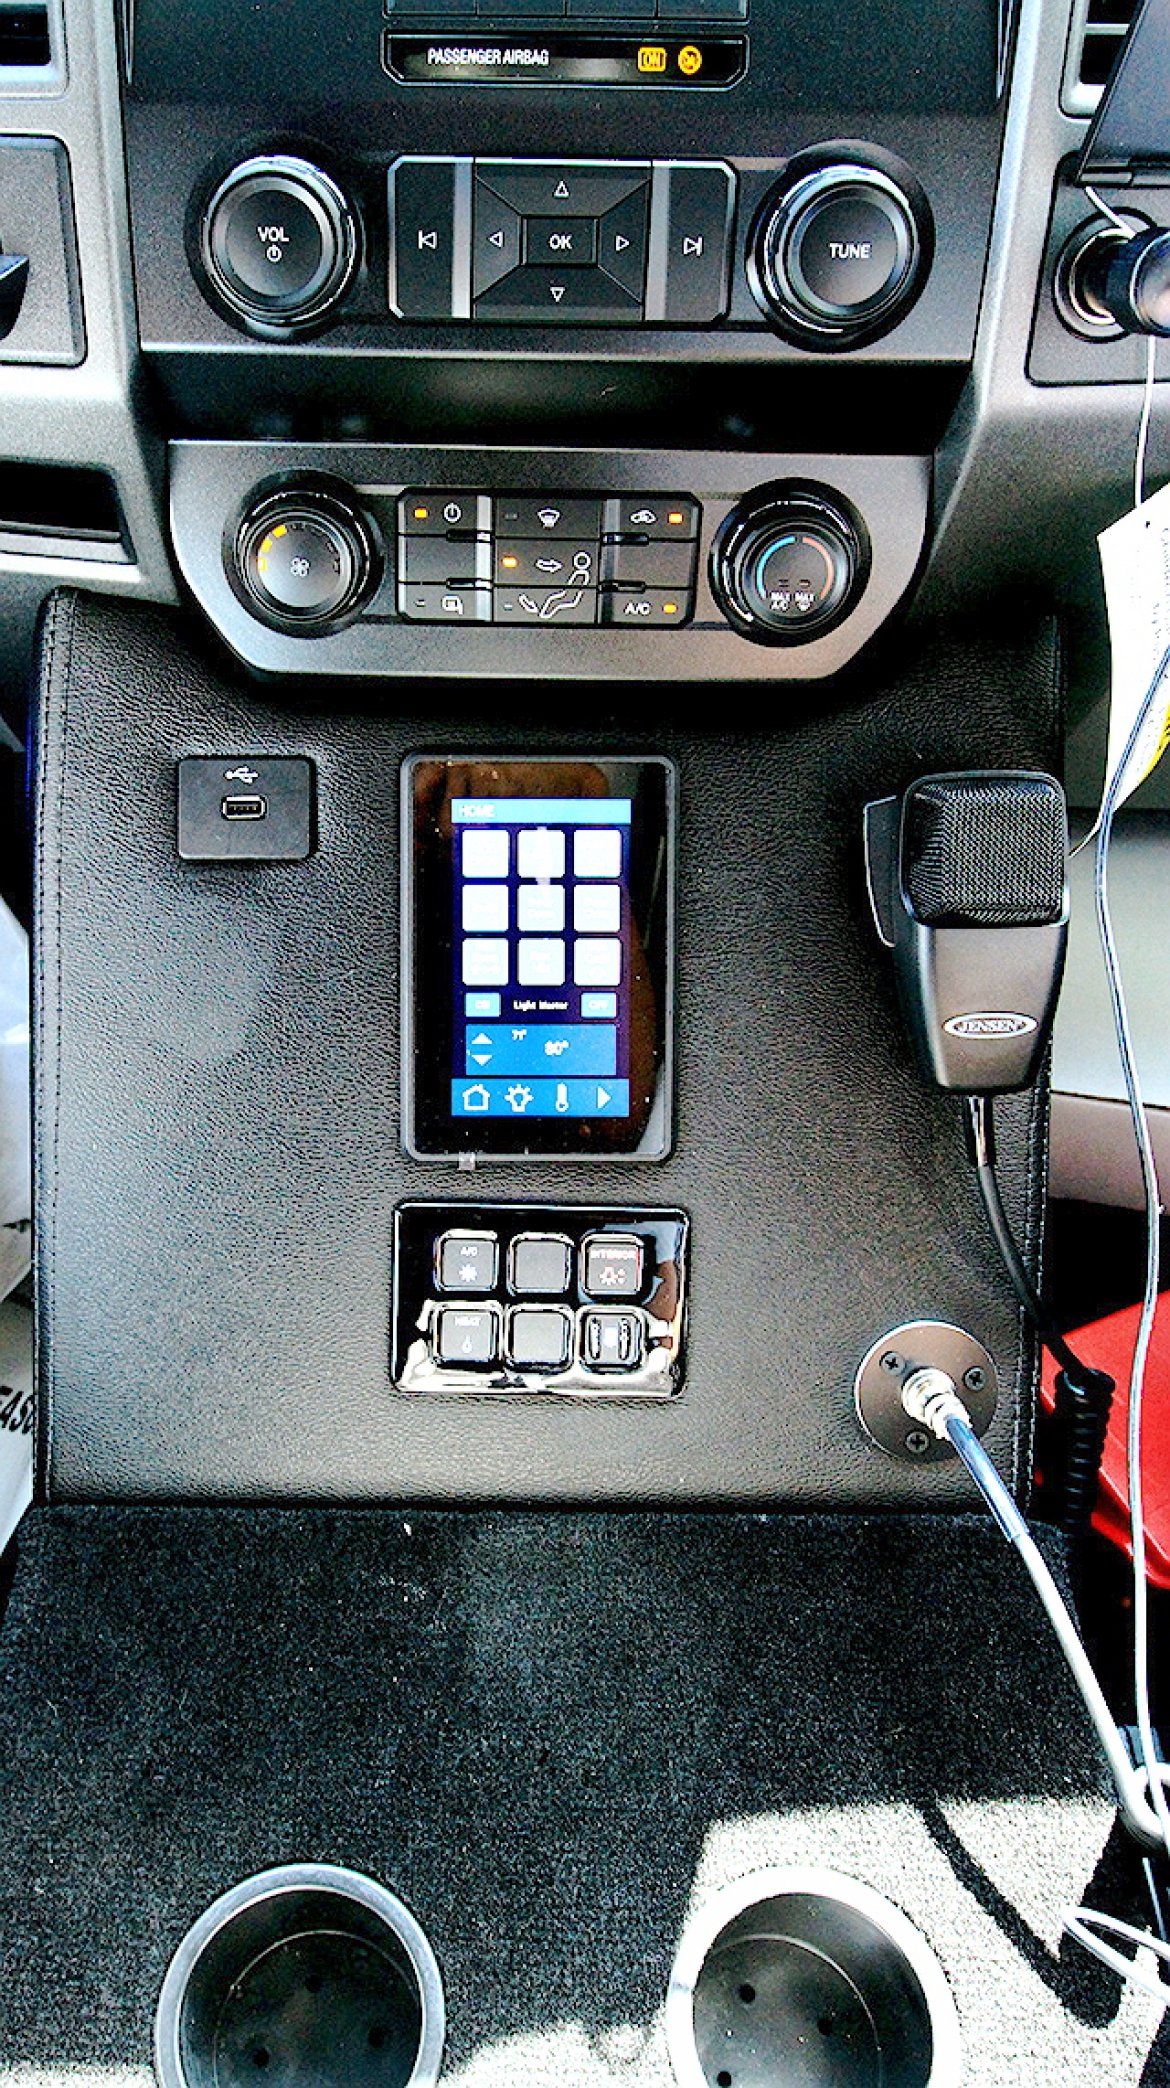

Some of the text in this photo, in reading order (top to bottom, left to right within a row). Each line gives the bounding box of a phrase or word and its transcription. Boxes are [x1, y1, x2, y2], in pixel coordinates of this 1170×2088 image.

[427, 47, 550, 66] PASSENGER AIRBAG
[257, 226, 290, 243] VOL
[549, 235, 572, 249] OK
[829, 242, 871, 259] TUNE
[624, 602, 650, 615] A/C
[459, 804, 496, 818] HOME
[513, 1000, 537, 1012] Light
[959, 1019, 1018, 1032] JENSEN
